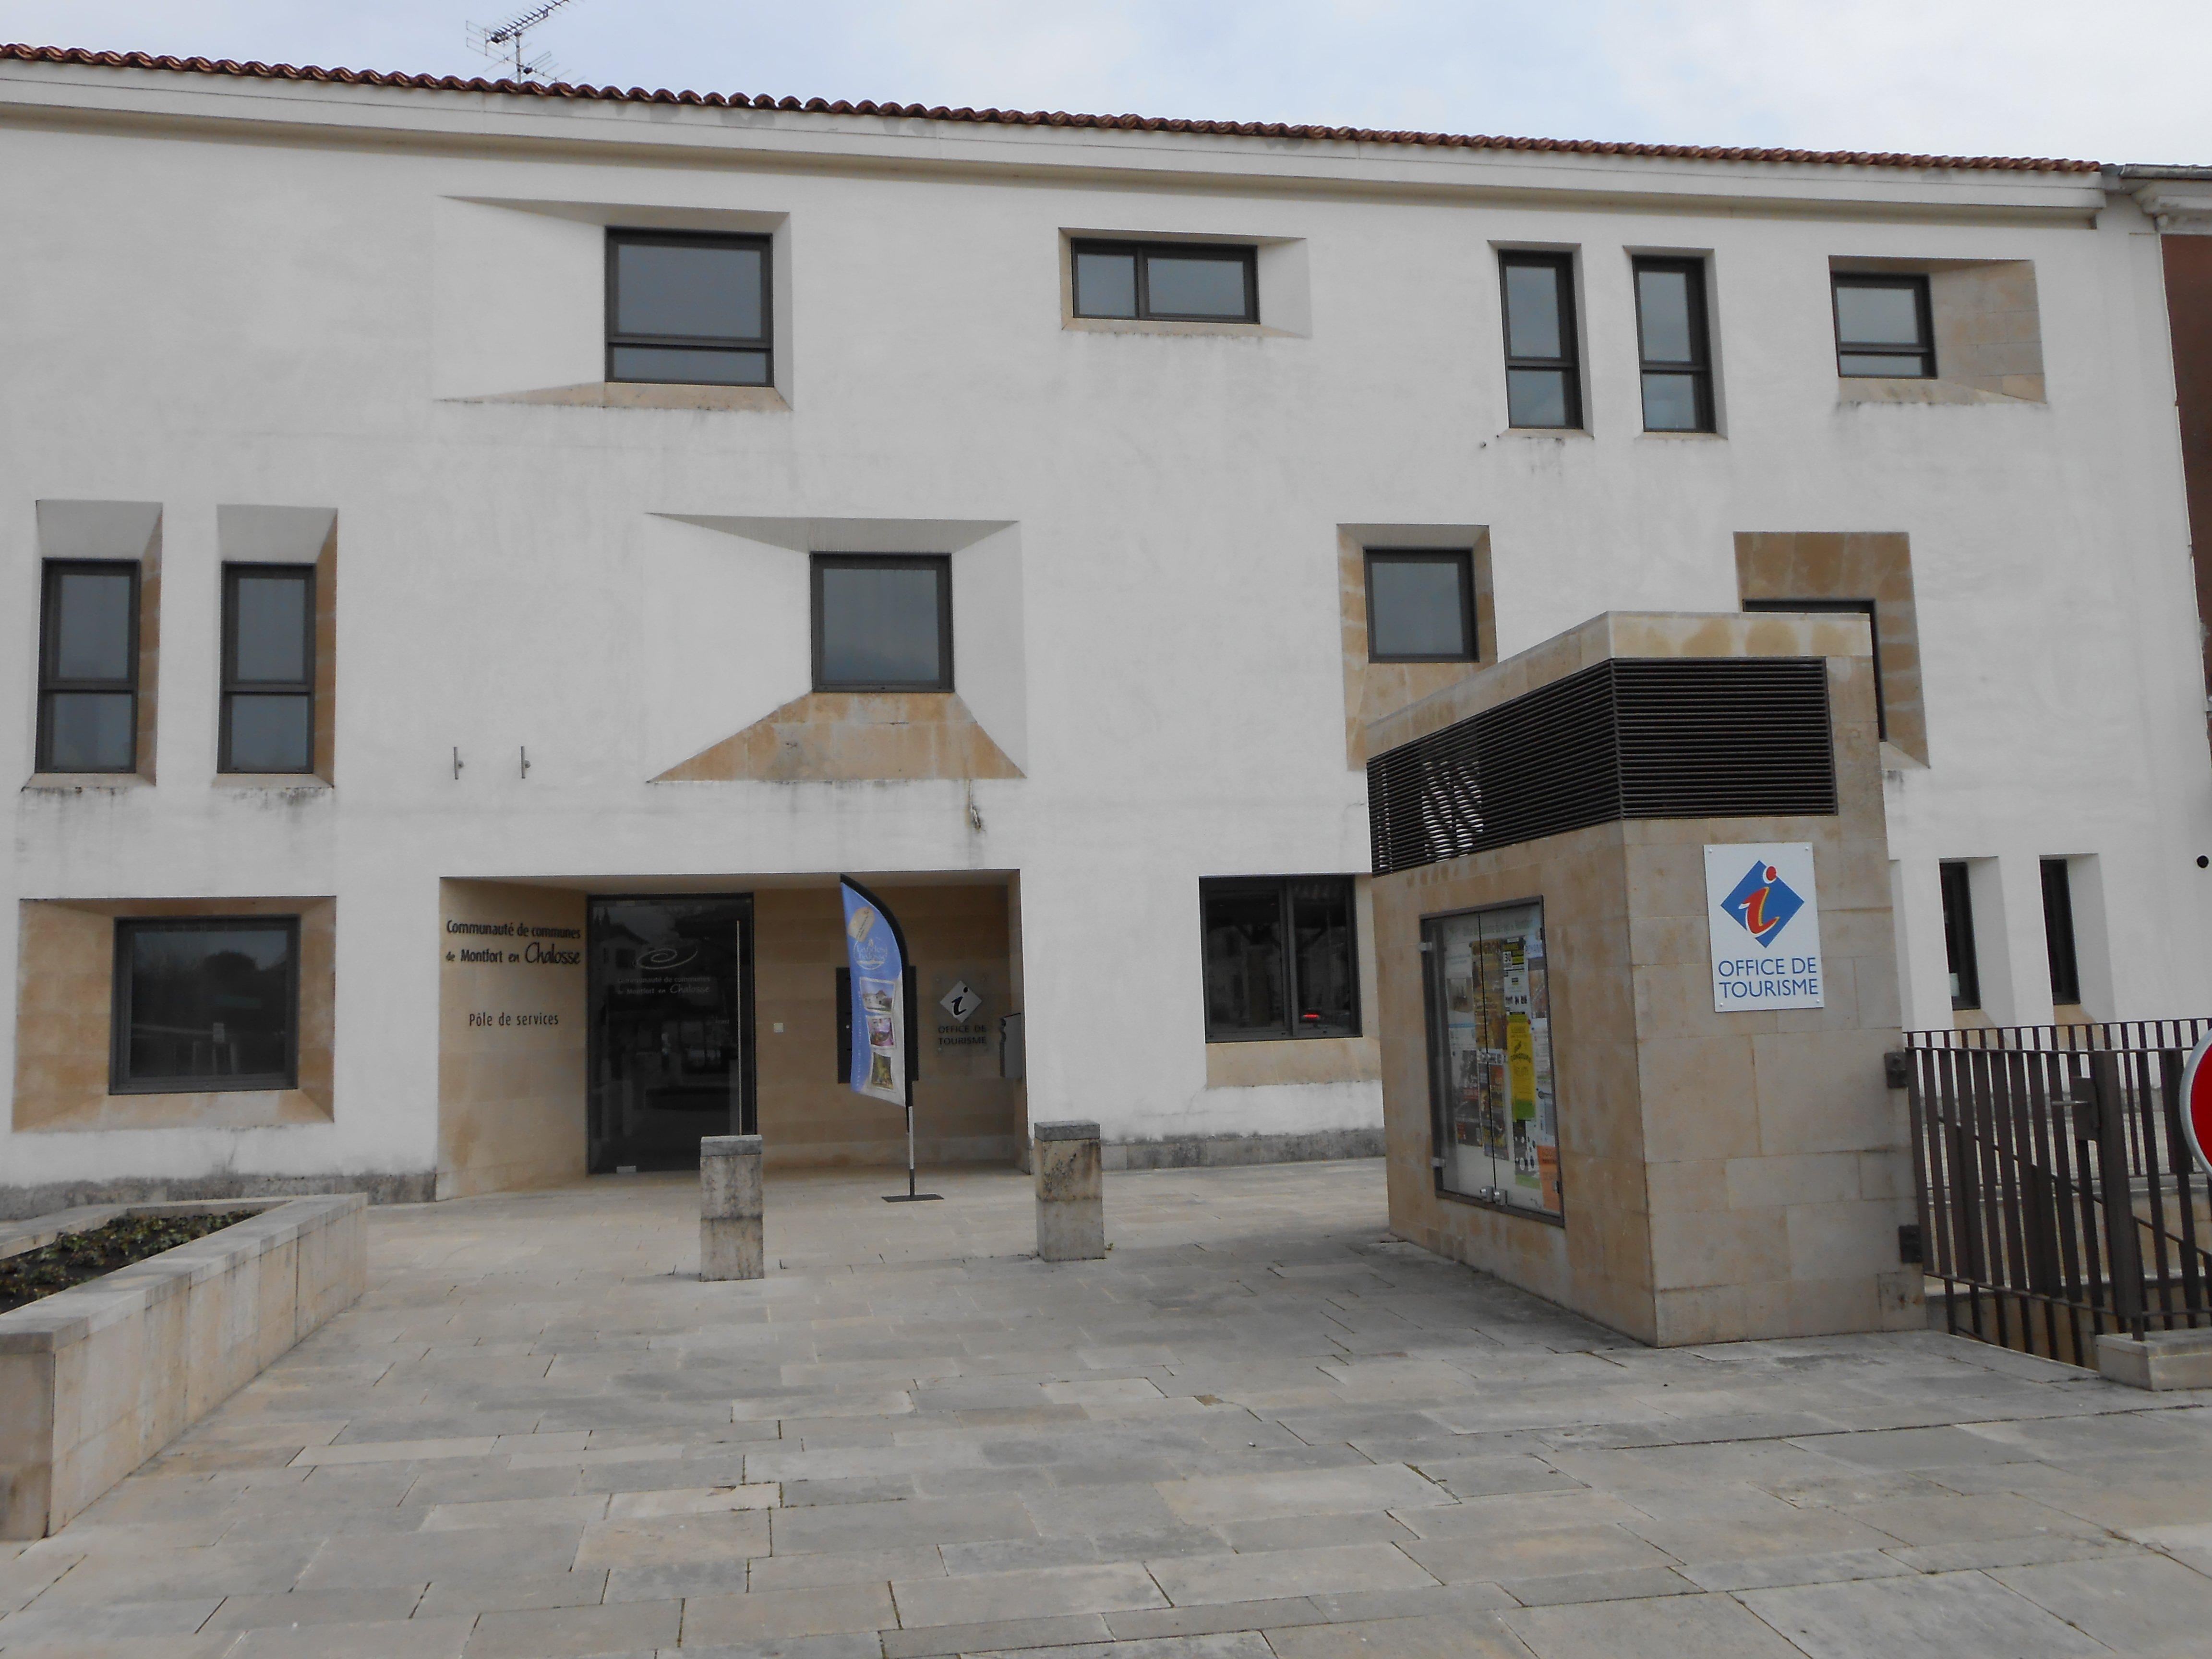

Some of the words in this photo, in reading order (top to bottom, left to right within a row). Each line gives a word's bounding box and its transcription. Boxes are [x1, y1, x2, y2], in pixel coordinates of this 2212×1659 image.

[447, 920, 514, 936] Communauté
[517, 923, 529, 937] de
[532, 927, 581, 938] communes
[445, 951, 455, 962] de
[460, 949, 503, 962] Montfort
[508, 952, 519, 962] en
[525, 942, 581, 964] Chalosse
[1718, 959, 1785, 977] OFFICE
[1791, 957, 1817, 974] DE
[1719, 978, 1818, 998] TOURISME
[469, 1012, 493, 1026] Pôle
[499, 1012, 511, 1026] de
[517, 1012, 558, 1025] services
[938, 1025, 969, 1033] OFFICE
[974, 1024, 986, 1033] DE
[938, 1036, 987, 1045] TOURISME
